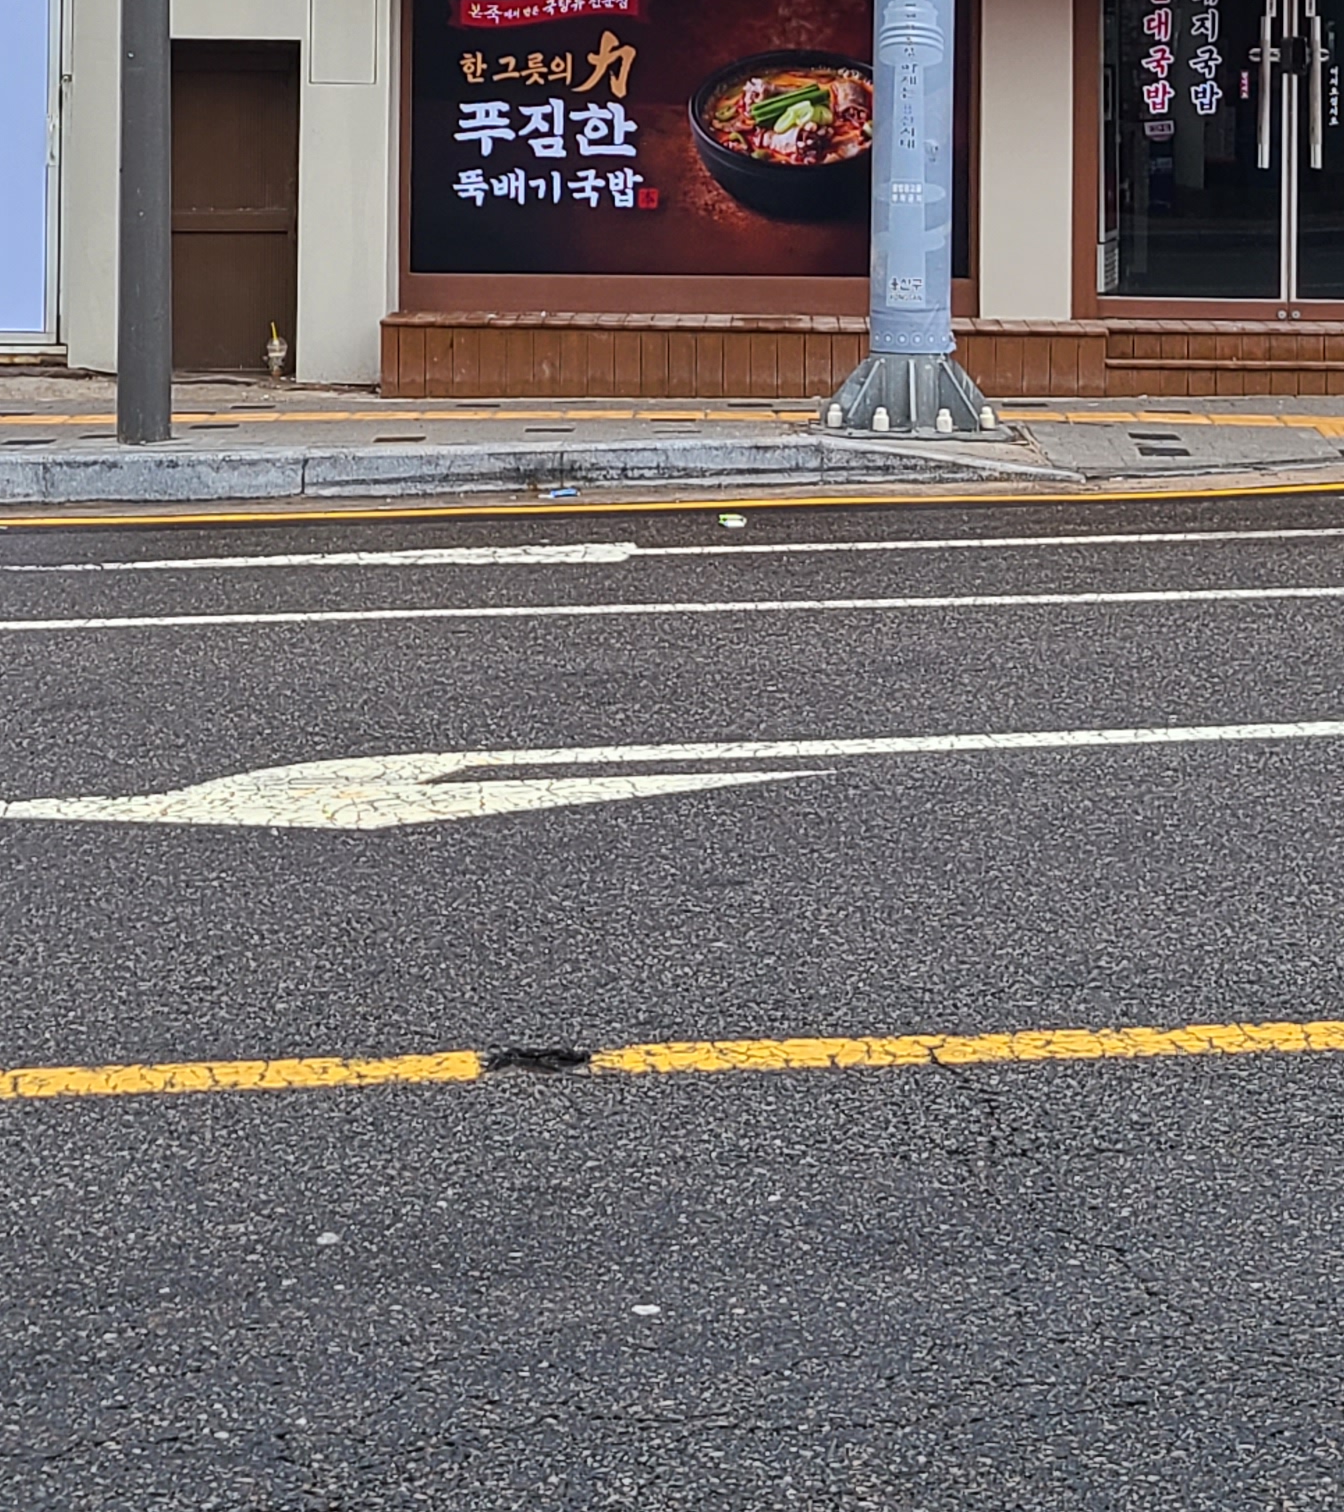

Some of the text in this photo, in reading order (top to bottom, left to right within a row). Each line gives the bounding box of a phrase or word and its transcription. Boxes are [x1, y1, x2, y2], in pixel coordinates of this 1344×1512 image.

[467, 2, 520, 25] 본죽에서
[458, 50, 573, 86] 한 그릇의
[570, 29, 637, 99] 力
[453, 97, 639, 158] 푸짐한
[890, 277, 923, 291] 용산구
